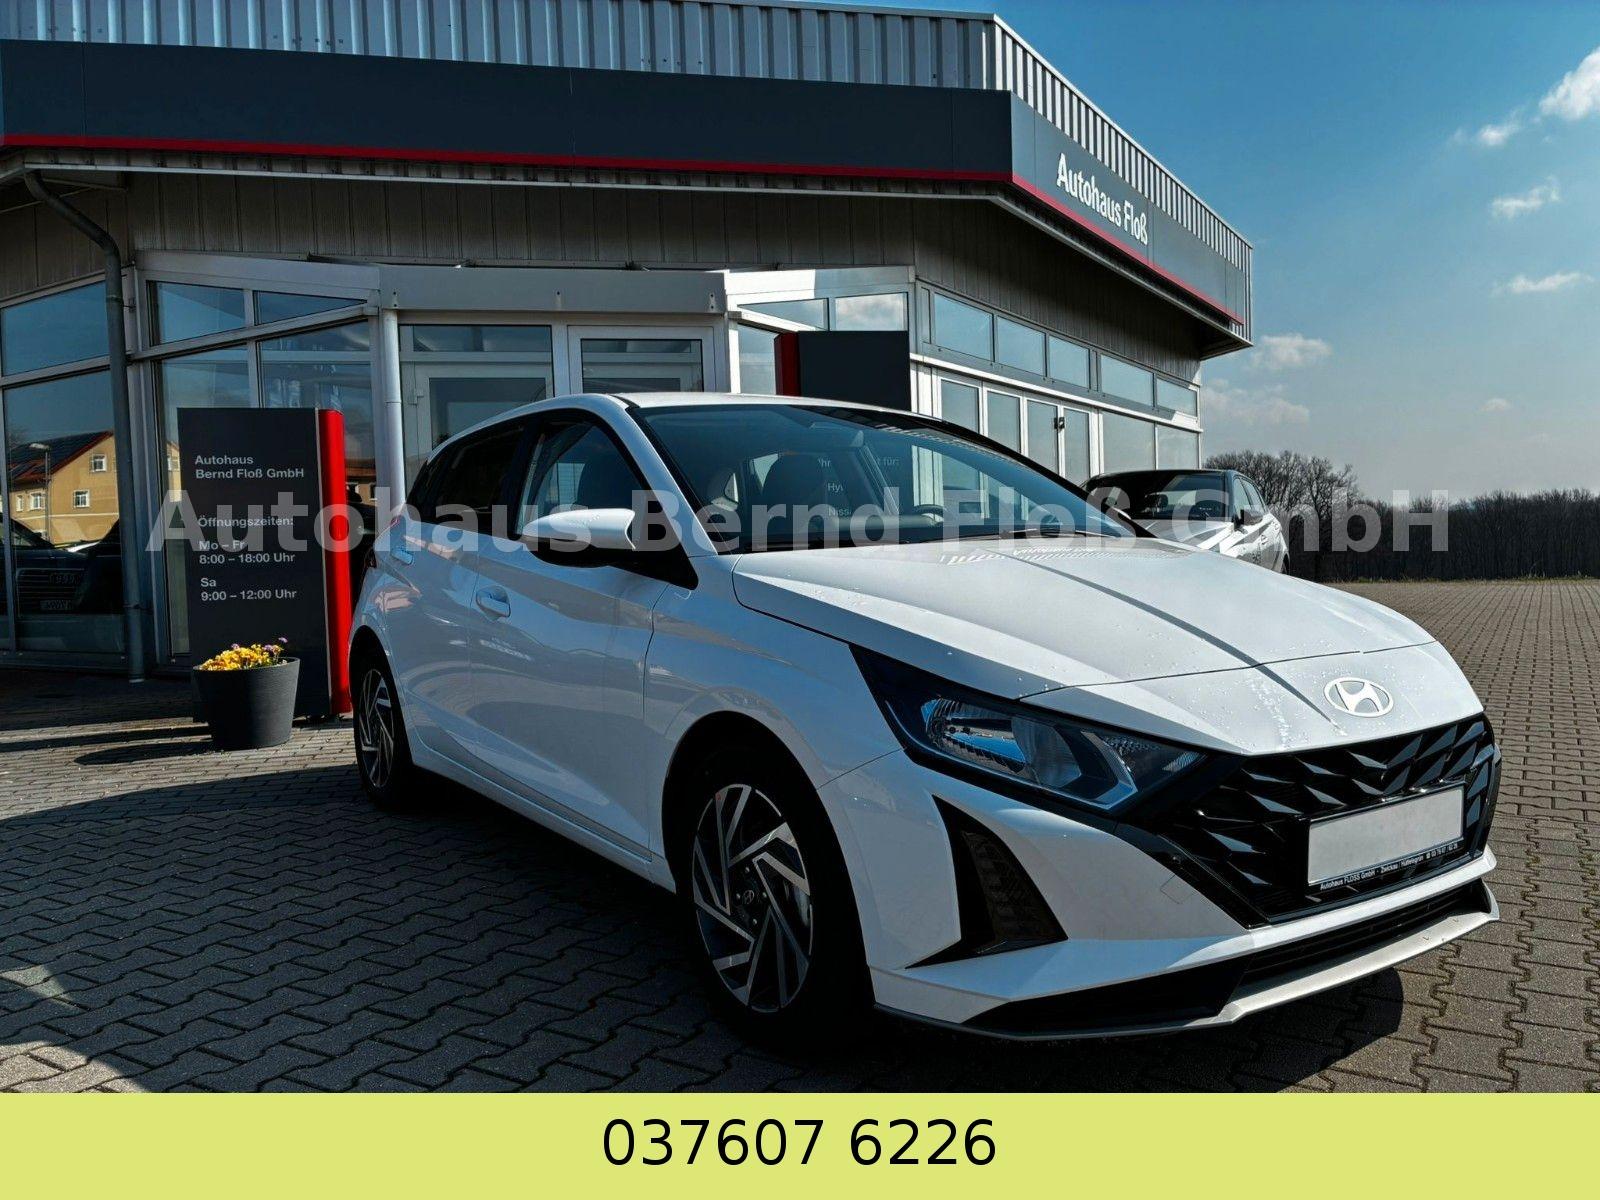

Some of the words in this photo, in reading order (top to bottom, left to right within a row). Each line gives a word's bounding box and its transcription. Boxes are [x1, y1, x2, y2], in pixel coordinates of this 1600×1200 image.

[1057, 152, 1122, 227] Autohaus
[1124, 200, 1148, 246] Floß
[195, 454, 254, 466] Autohaus
[196, 468, 233, 479] Bernd
[237, 468, 263, 479] Floß
[266, 468, 305, 479] GmbH
[198, 514, 294, 528] Öffnungszeiten:
[199, 540, 218, 551] Mo
[232, 540, 245, 550] Fr
[199, 554, 225, 565] 8:00
[238, 553, 270, 564] 18:00
[273, 552, 295, 563] Uhr
[200, 577, 217, 588] Sa
[201, 590, 227, 602] 9:00
[240, 589, 271, 600] 12:00
[275, 588, 297, 600] Uhr
